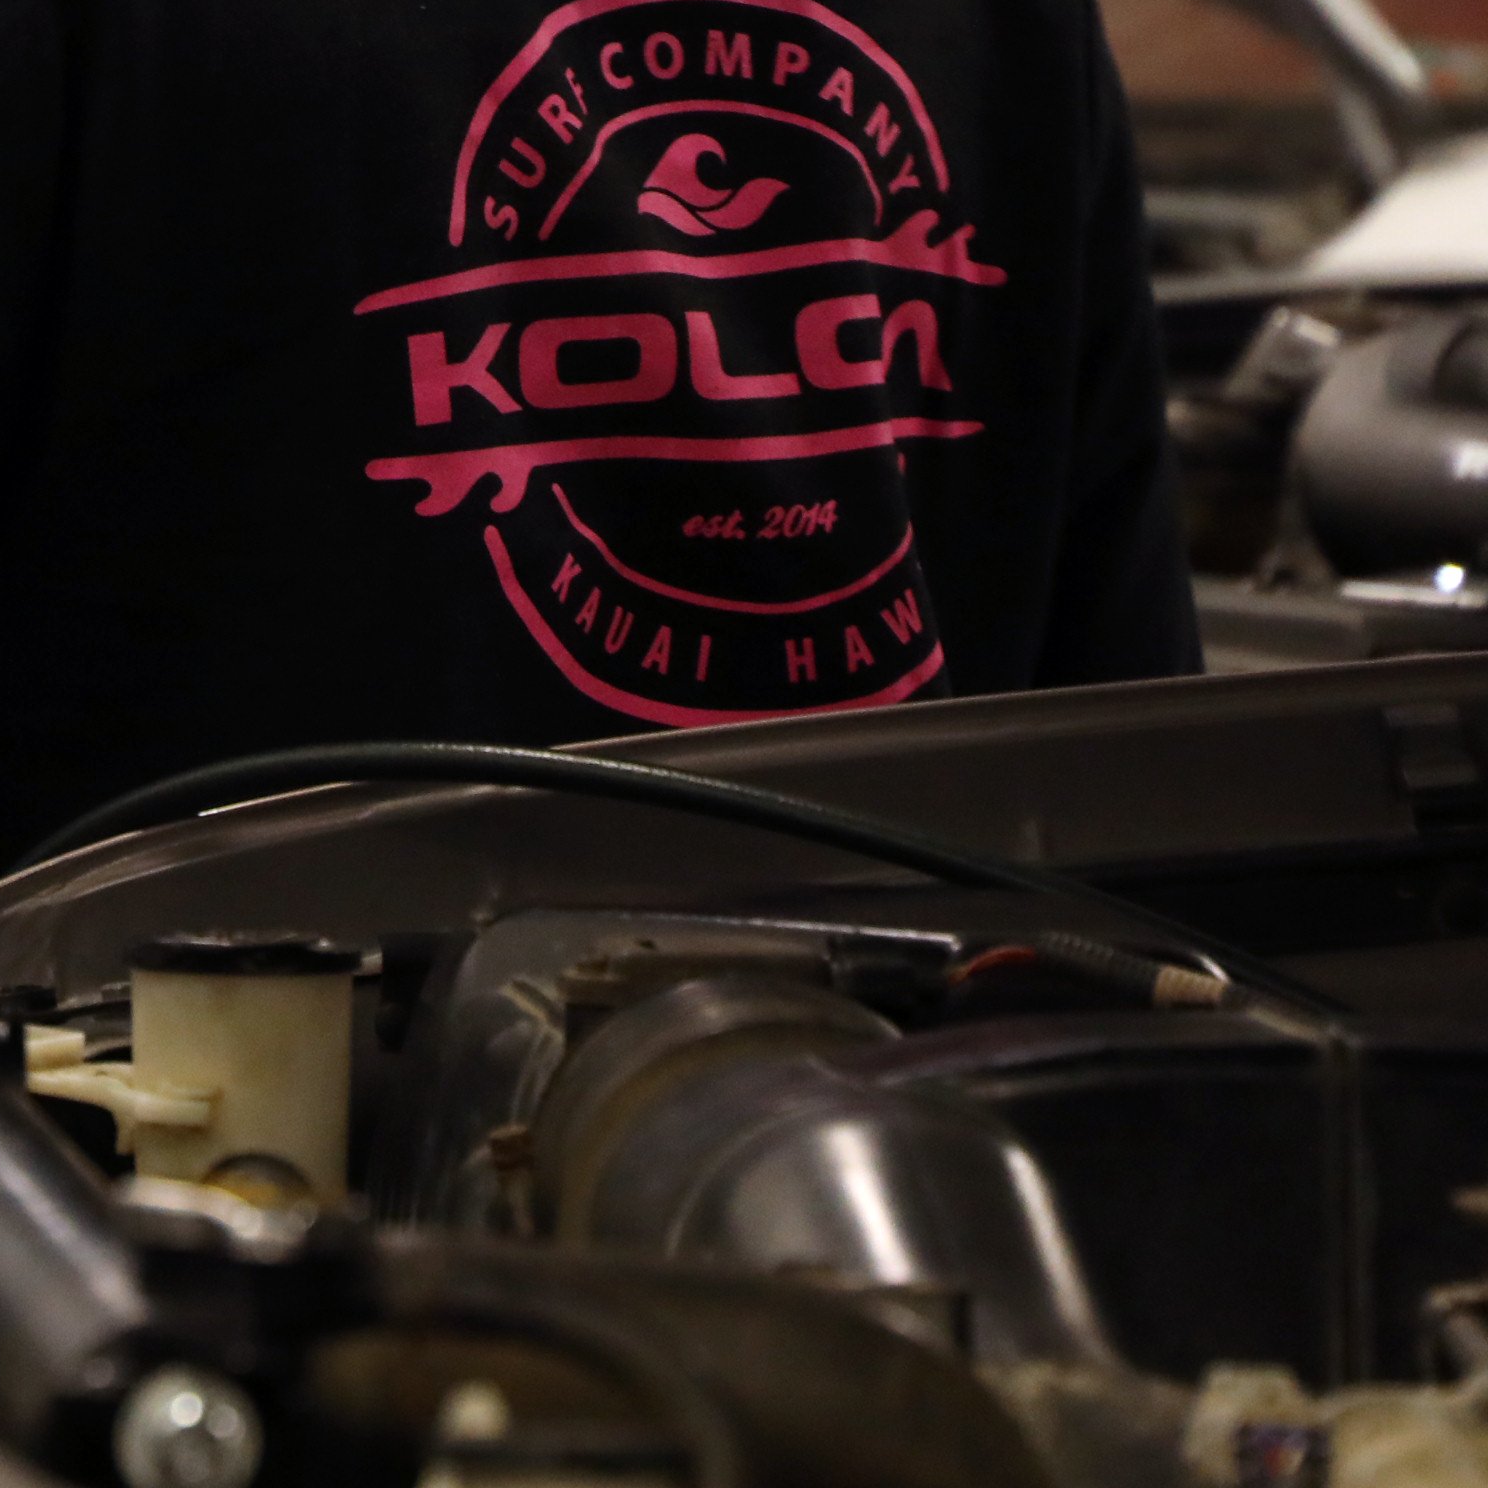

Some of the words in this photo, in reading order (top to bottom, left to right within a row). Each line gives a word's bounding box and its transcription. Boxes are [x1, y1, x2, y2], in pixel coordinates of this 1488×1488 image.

[599, 28, 922, 195] COMPANY
[681, 509, 745, 540] est.
[756, 498, 839, 539] 2014
[550, 552, 713, 683] KAUAI
